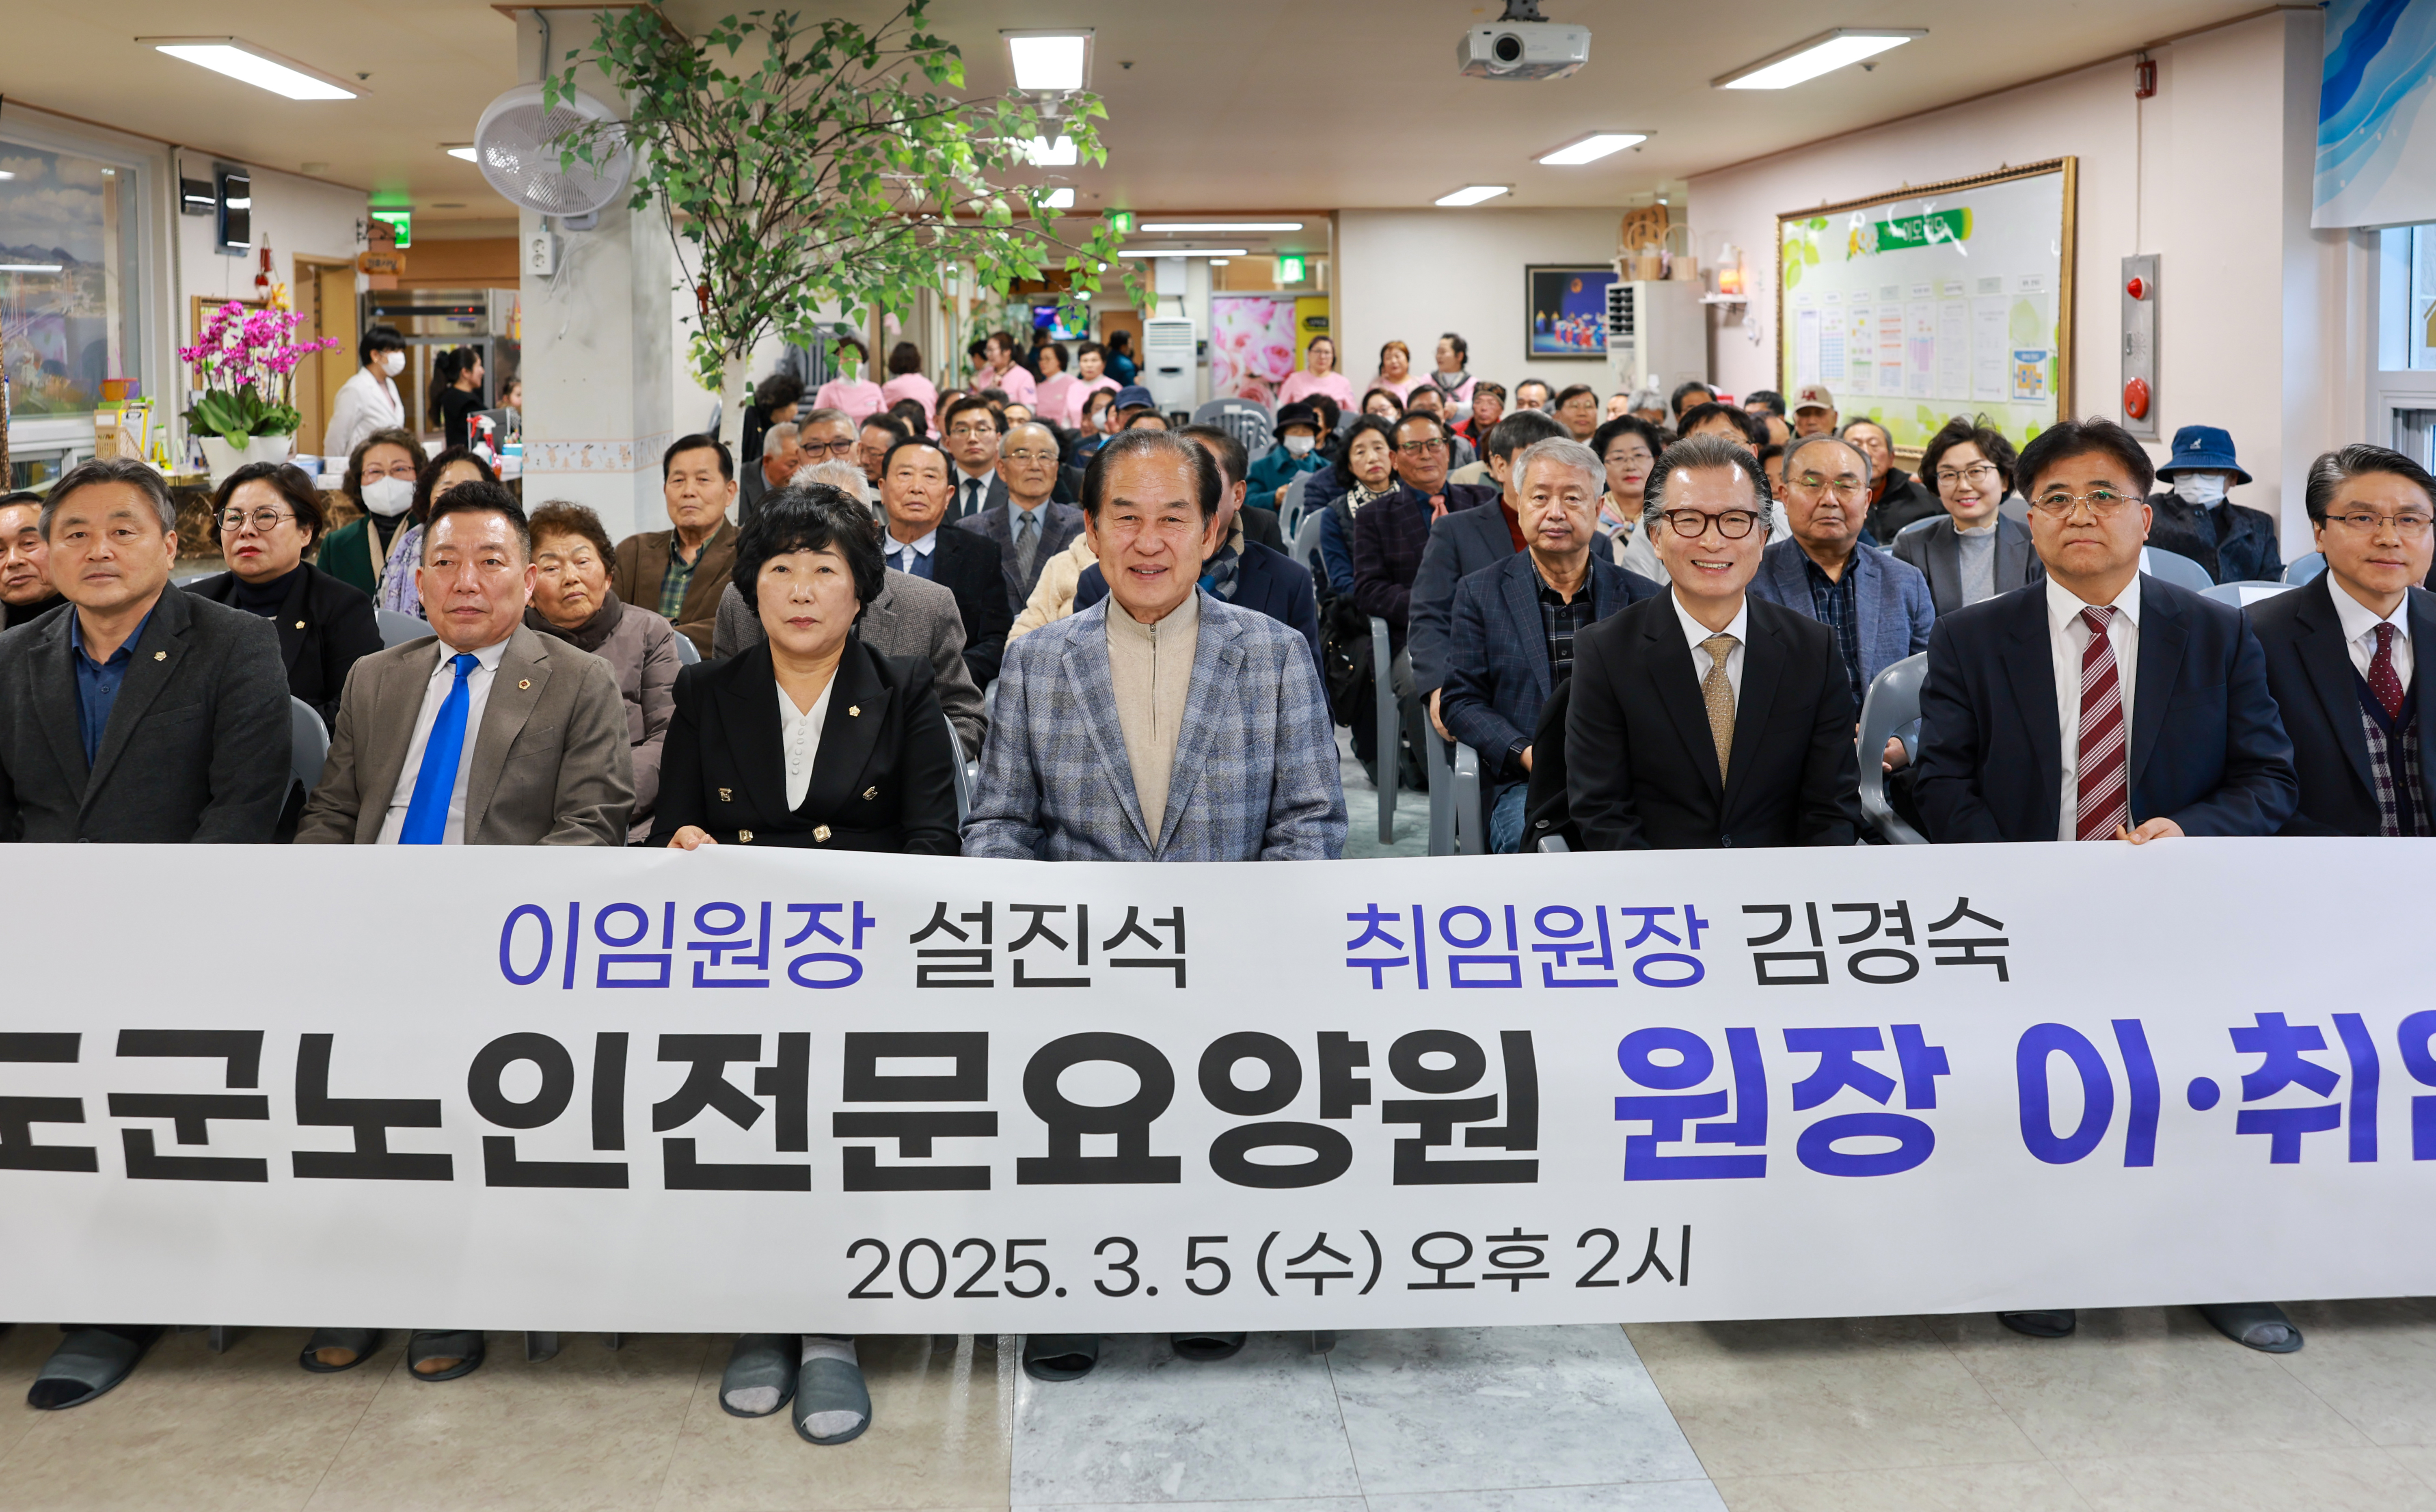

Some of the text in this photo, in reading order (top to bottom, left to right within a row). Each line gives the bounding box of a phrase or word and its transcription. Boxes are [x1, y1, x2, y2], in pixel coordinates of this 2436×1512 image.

[500, 897, 2009, 989] 이임원장 설진석 취임원장 김경숙
[1615, 1024, 1950, 1181] 원장
[2017, 1010, 2436, 1167] 이·취
[847, 1238, 1067, 1299] 2025.
[1094, 1237, 1158, 1297] 3.
[1408, 1227, 1549, 1292] 오후
[1576, 1225, 1691, 1287] 2시
